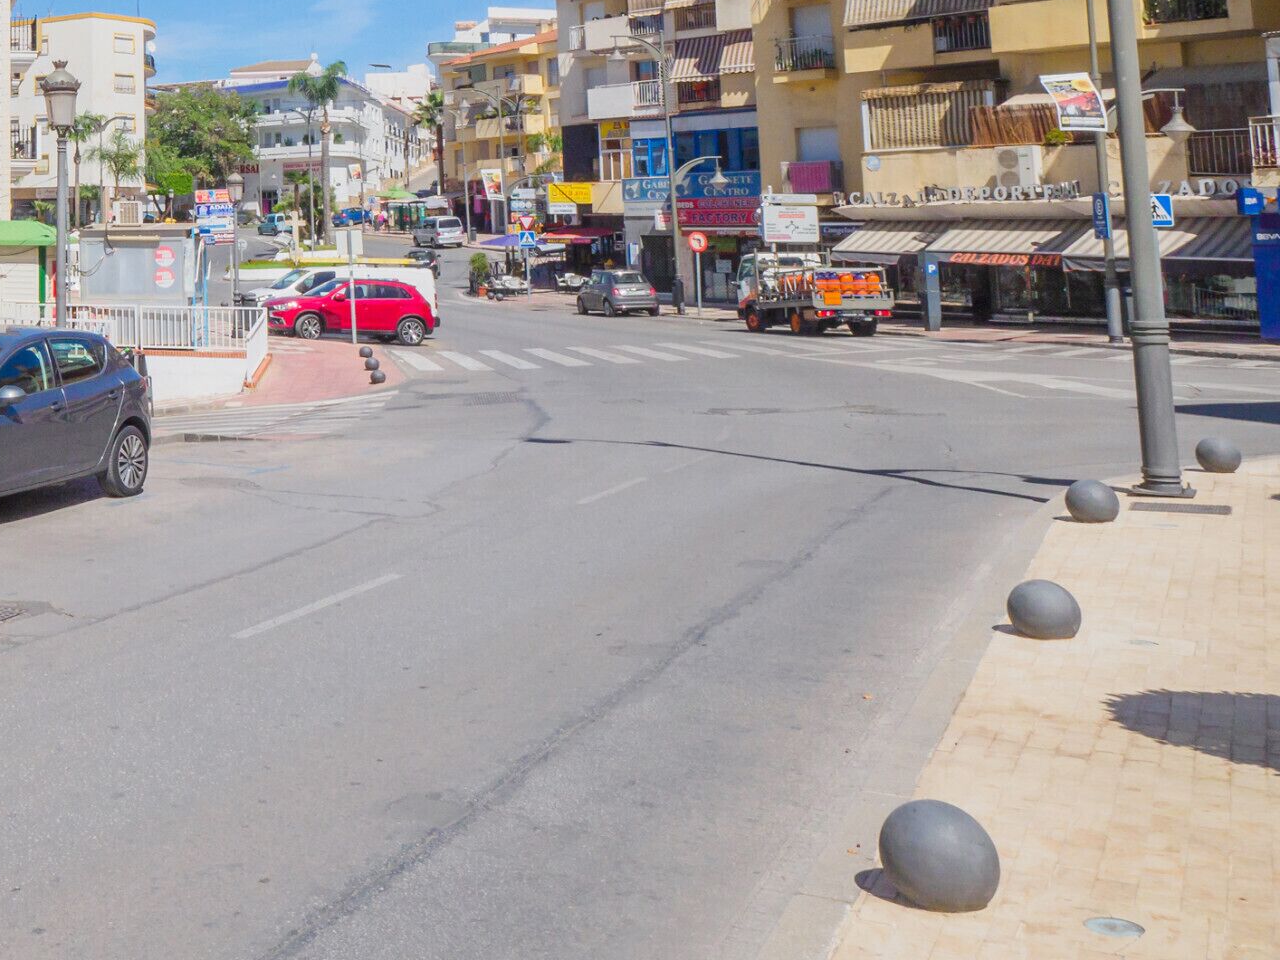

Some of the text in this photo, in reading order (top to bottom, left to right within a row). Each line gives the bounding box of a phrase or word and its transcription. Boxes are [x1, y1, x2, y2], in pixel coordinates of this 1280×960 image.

[703, 187, 750, 197] CENTRO
[691, 212, 747, 223] FACTORY
[949, 252, 1030, 265] CALZADOS
[927, 264, 936, 273] P
